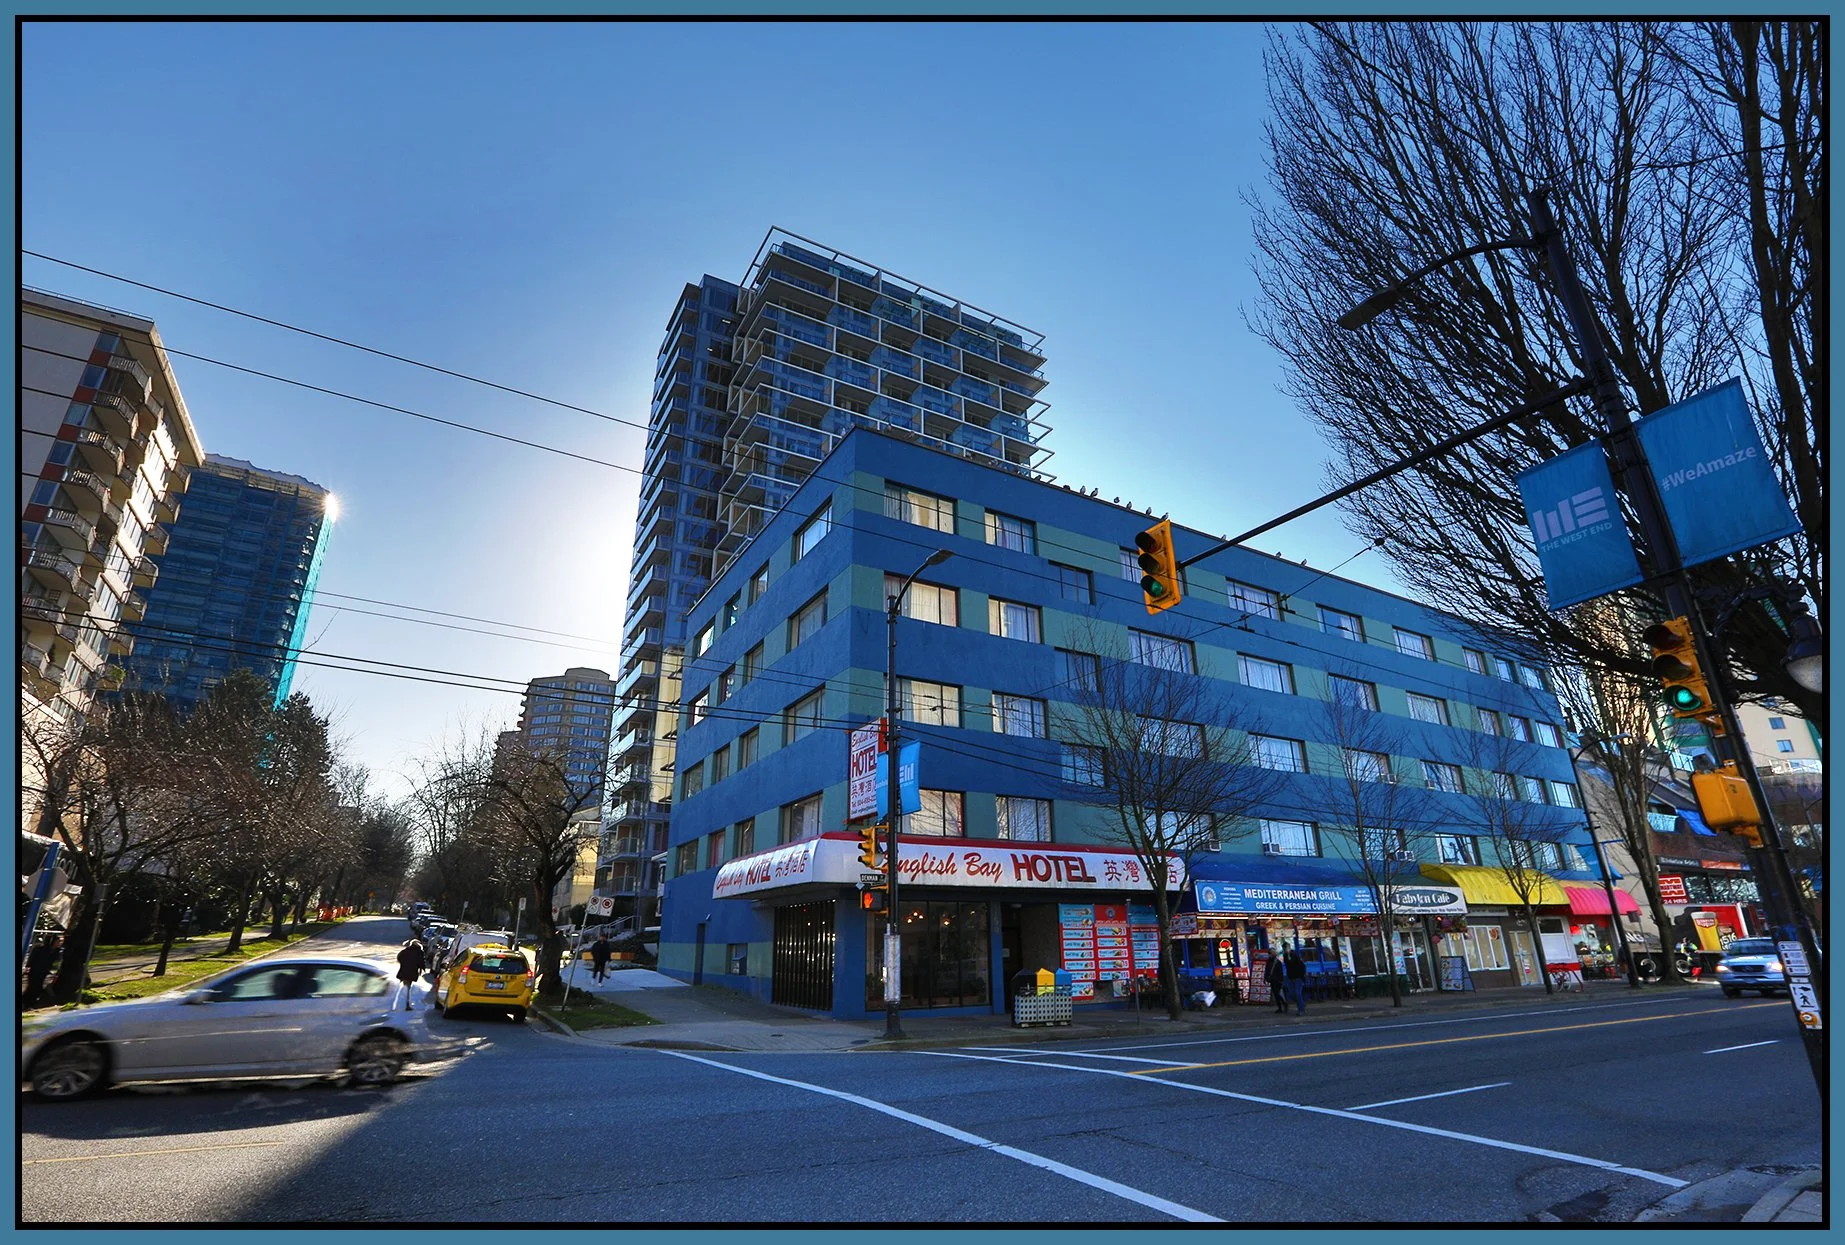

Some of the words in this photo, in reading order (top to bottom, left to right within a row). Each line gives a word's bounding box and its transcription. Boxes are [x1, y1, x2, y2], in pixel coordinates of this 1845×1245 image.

[1661, 446, 1758, 492] #WeAmaze
[1541, 540, 1560, 553] THE
[1560, 530, 1588, 547] WEST
[1590, 521, 1613, 537] END
[852, 744, 877, 779] HOTEL
[746, 858, 772, 886] HOTEL
[963, 852, 1003, 883] Bay
[1010, 853, 1096, 883] HOTEL
[1244, 888, 1318, 901] MEDITERRANEAN
[1320, 891, 1342, 901] GRILL
[1255, 902, 1277, 910] GREEK
[1284, 902, 1311, 911] PERSIAN
[1312, 903, 1336, 911] CUISINE
[1720, 932, 1737, 945] 1516
